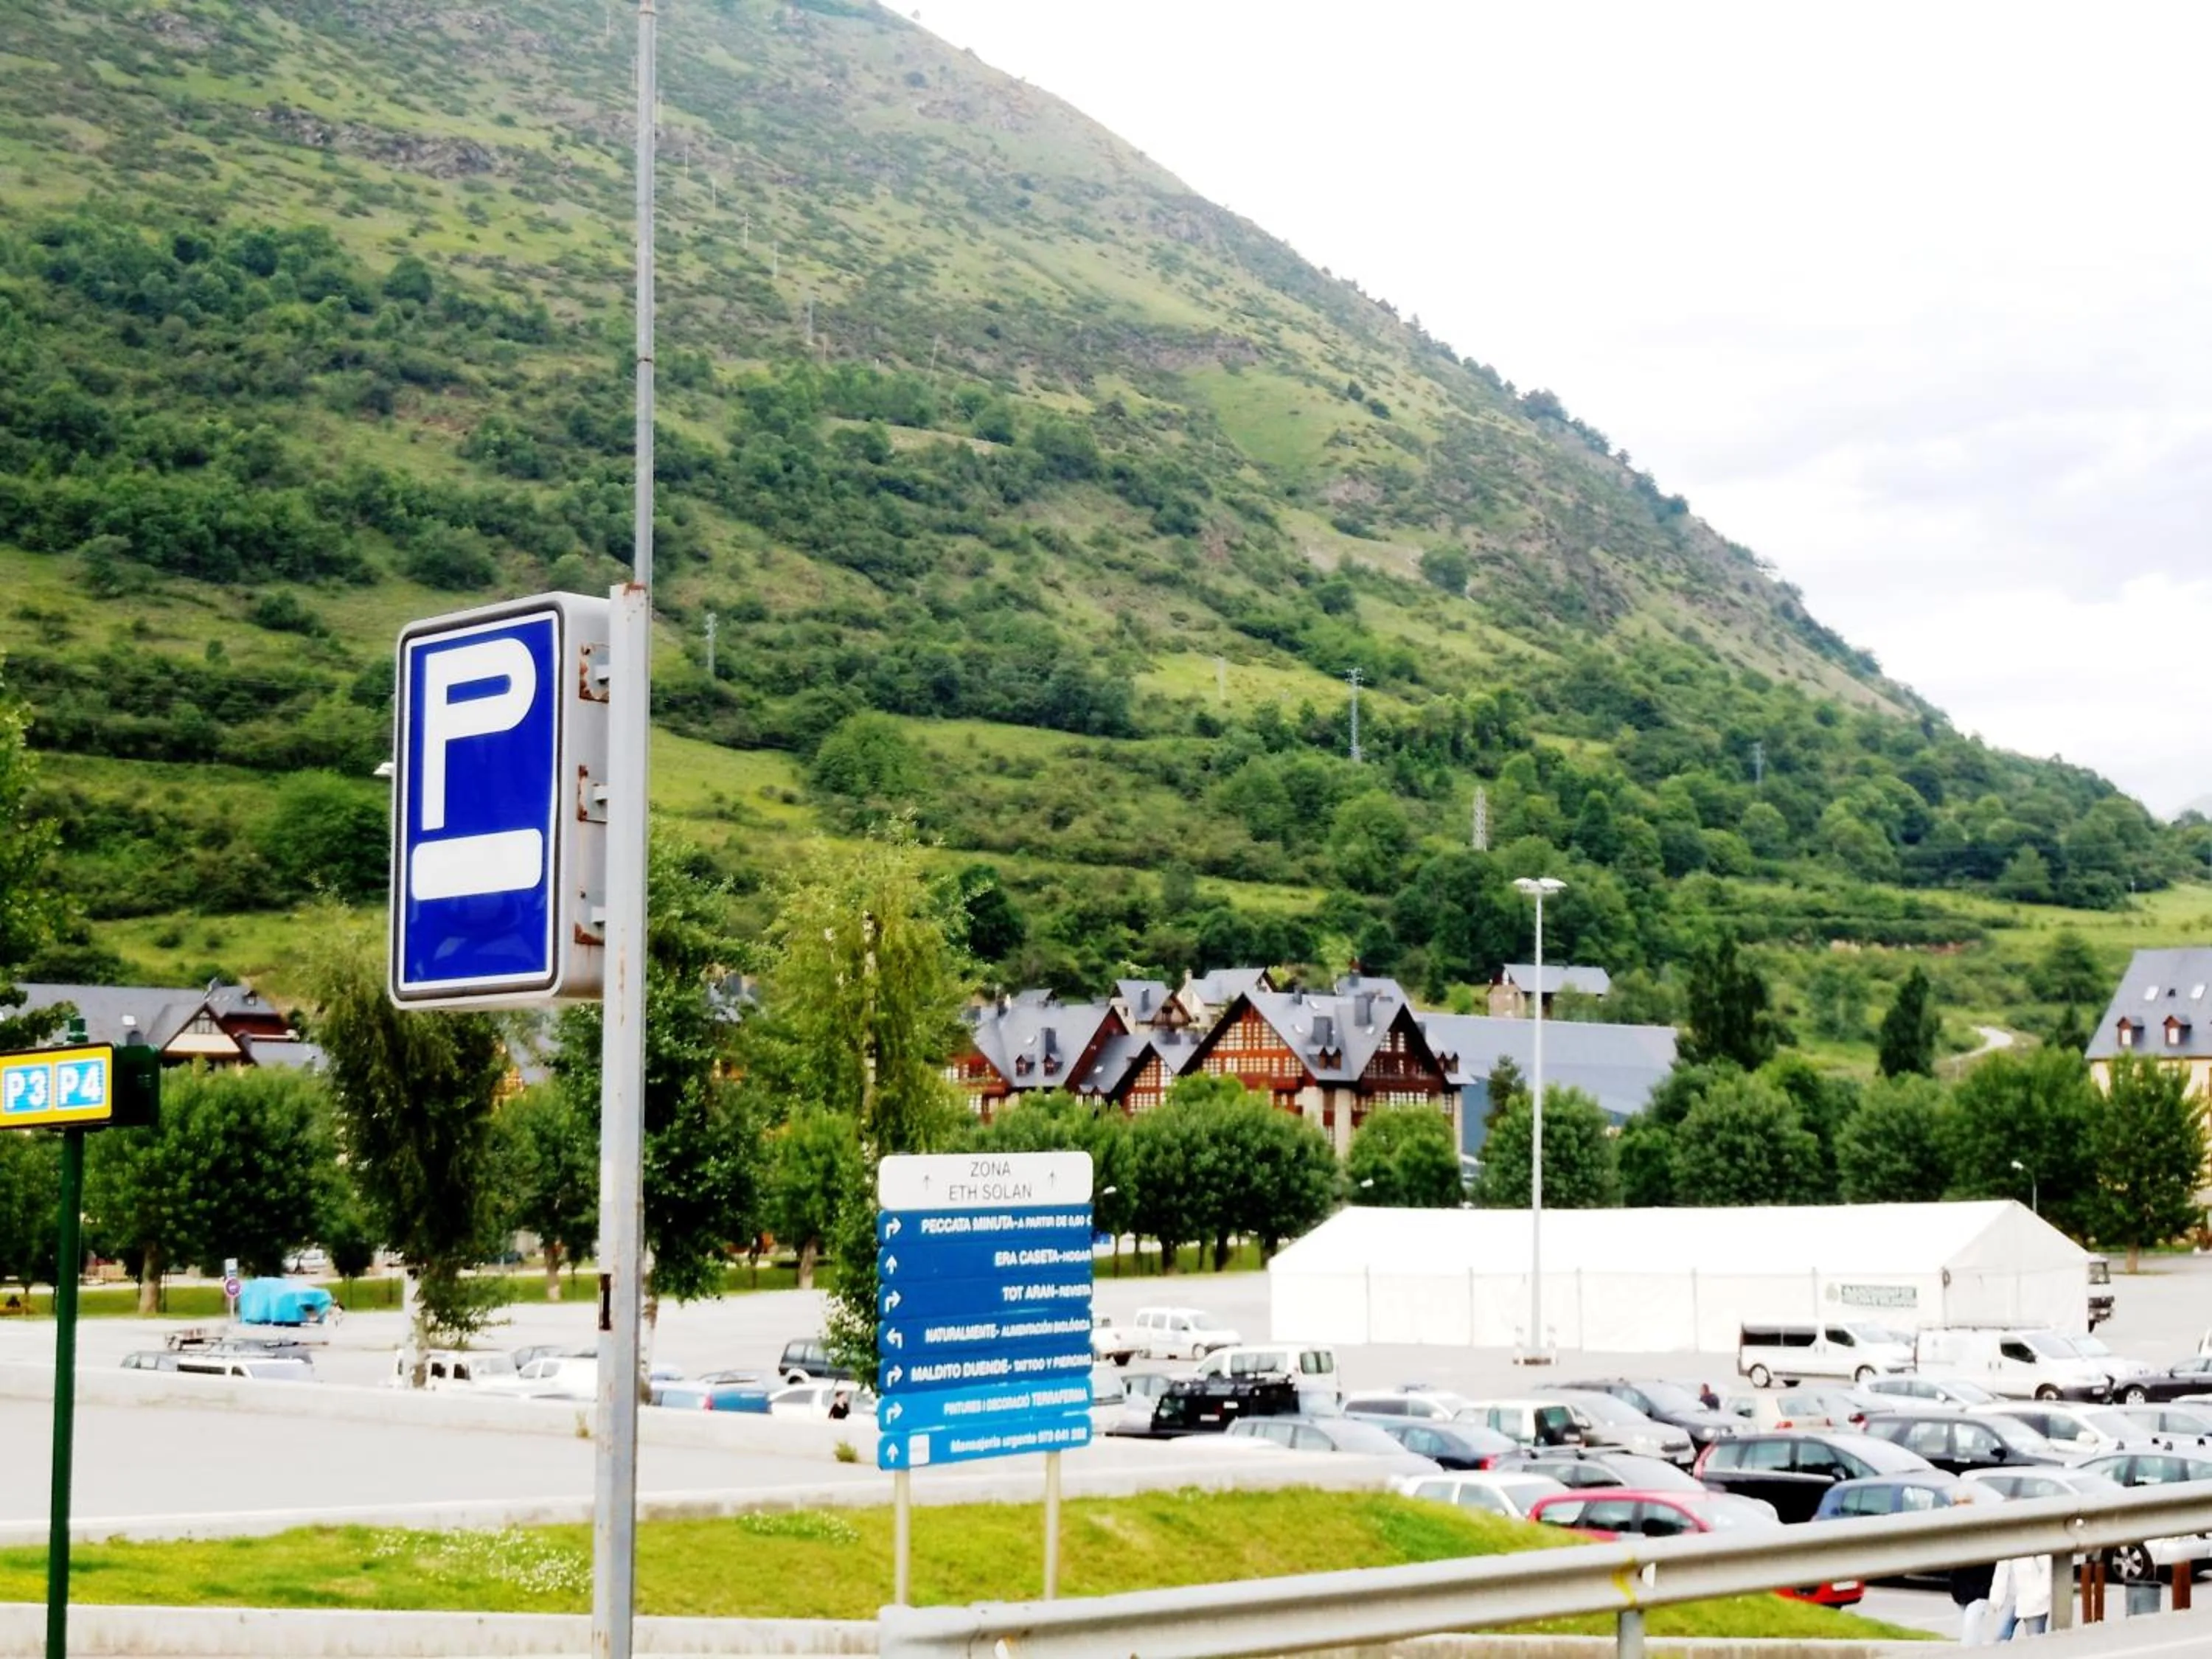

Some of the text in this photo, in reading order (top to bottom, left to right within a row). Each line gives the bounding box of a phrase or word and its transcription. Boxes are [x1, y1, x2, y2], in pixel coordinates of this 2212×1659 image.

[422, 637, 537, 832] P
[6, 1064, 100, 1109] P3 P4
[970, 1161, 1011, 1178] ZONA
[949, 1183, 1032, 1202] ETH SOLAN
[922, 1217, 971, 1233] PECCATA
[995, 1251, 1018, 1266] ERA
[1003, 1286, 1023, 1301] TOT
[911, 1363, 961, 1381] MALDITO
